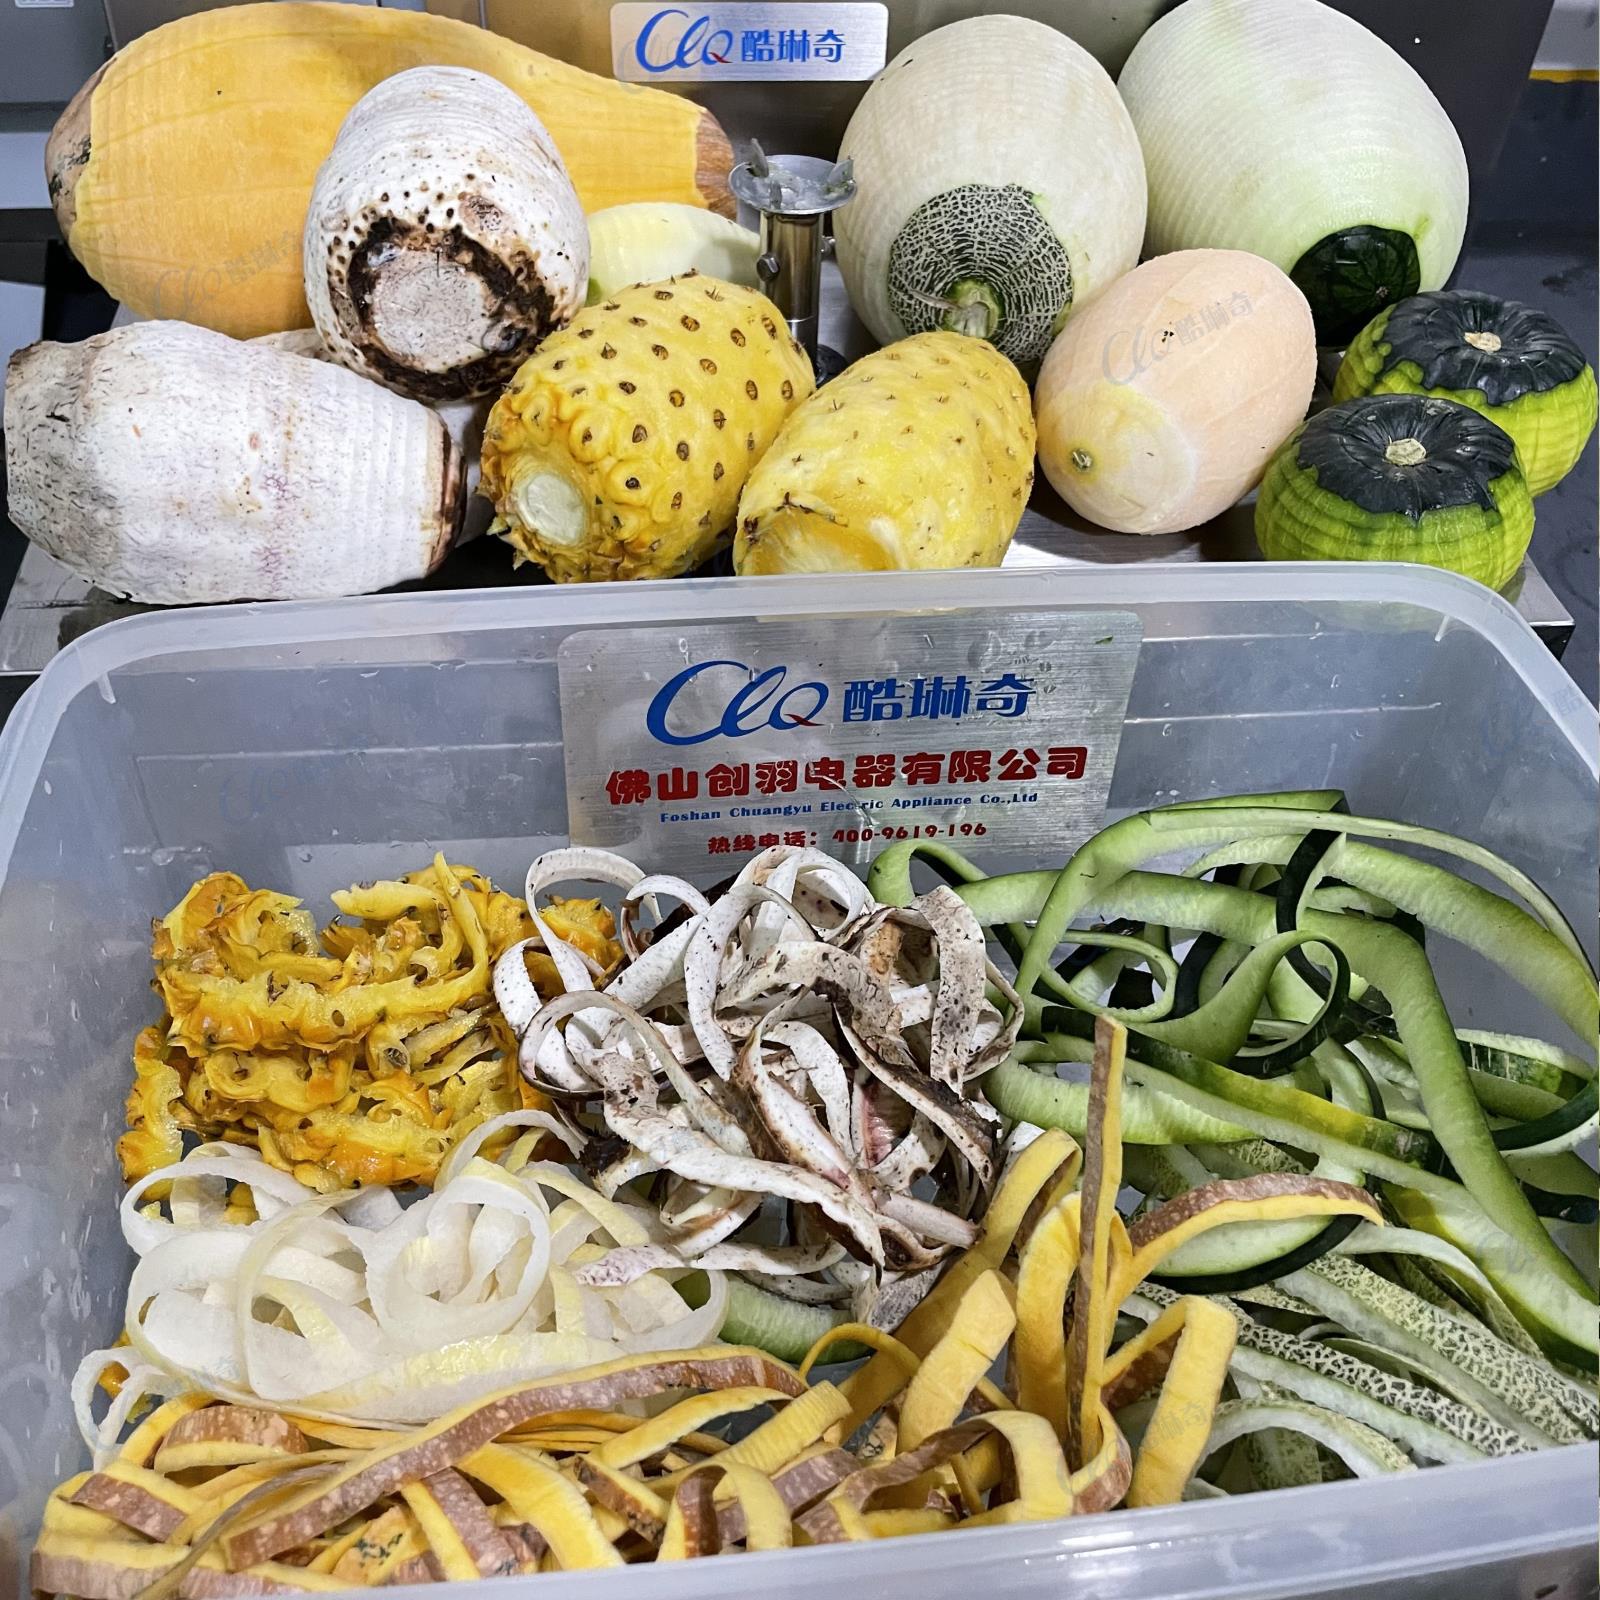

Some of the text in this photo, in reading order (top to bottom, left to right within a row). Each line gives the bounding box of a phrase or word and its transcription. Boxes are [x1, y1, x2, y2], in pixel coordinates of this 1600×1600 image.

[740, 29, 846, 63] 酷琳奇
[843, 673, 1036, 722] 酷琳奇
[606, 746, 1088, 805] 佛山创羽电器有限公司
[660, 811, 721, 823] Foshan
[729, 804, 812, 816] Chuangyu
[820, 800, 884, 812] Elecric
[891, 795, 972, 809] Appliance
[833, 823, 987, 843] 400-9619-196
